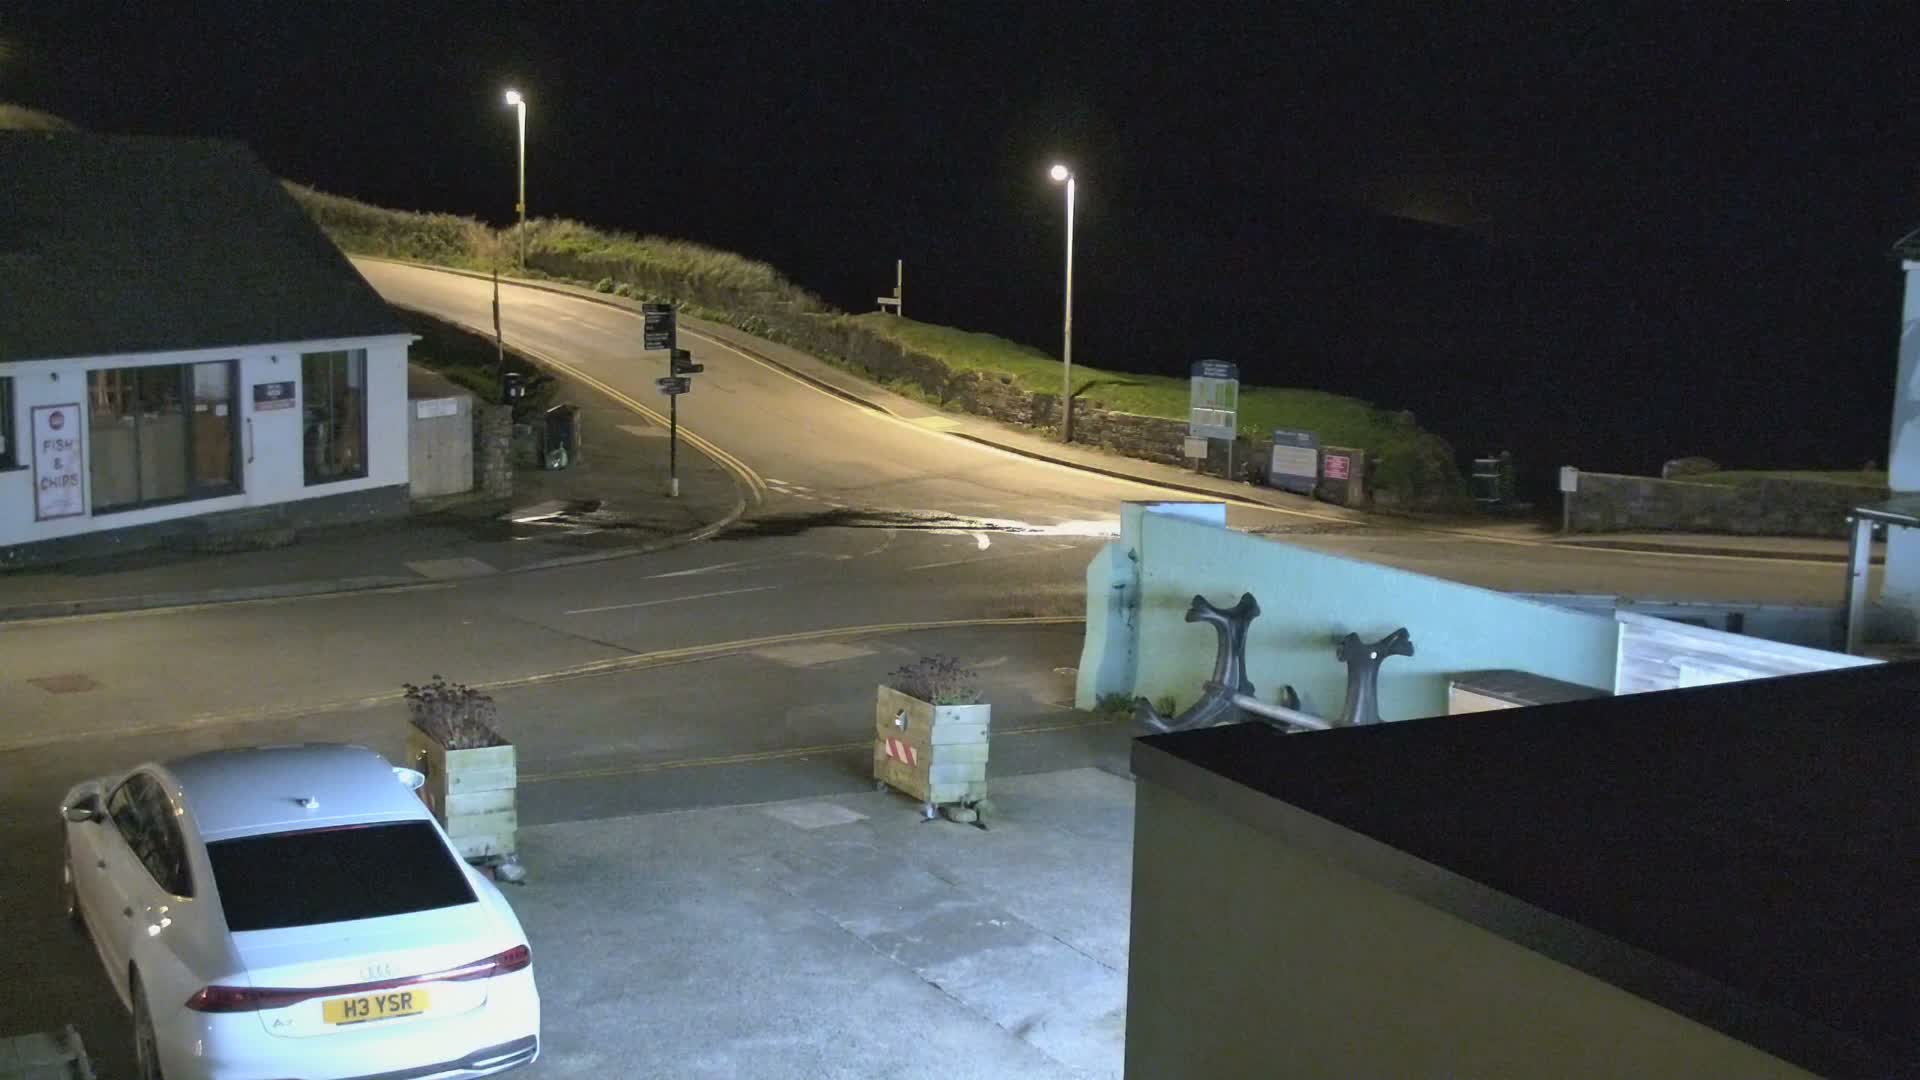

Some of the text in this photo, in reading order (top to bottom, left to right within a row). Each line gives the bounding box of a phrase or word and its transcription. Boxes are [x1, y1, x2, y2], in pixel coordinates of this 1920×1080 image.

[43, 438, 73, 453] FISH
[54, 457, 64, 470] &
[40, 474, 78, 490] CHIPS
[344, 992, 412, 1018] H3 YSR
